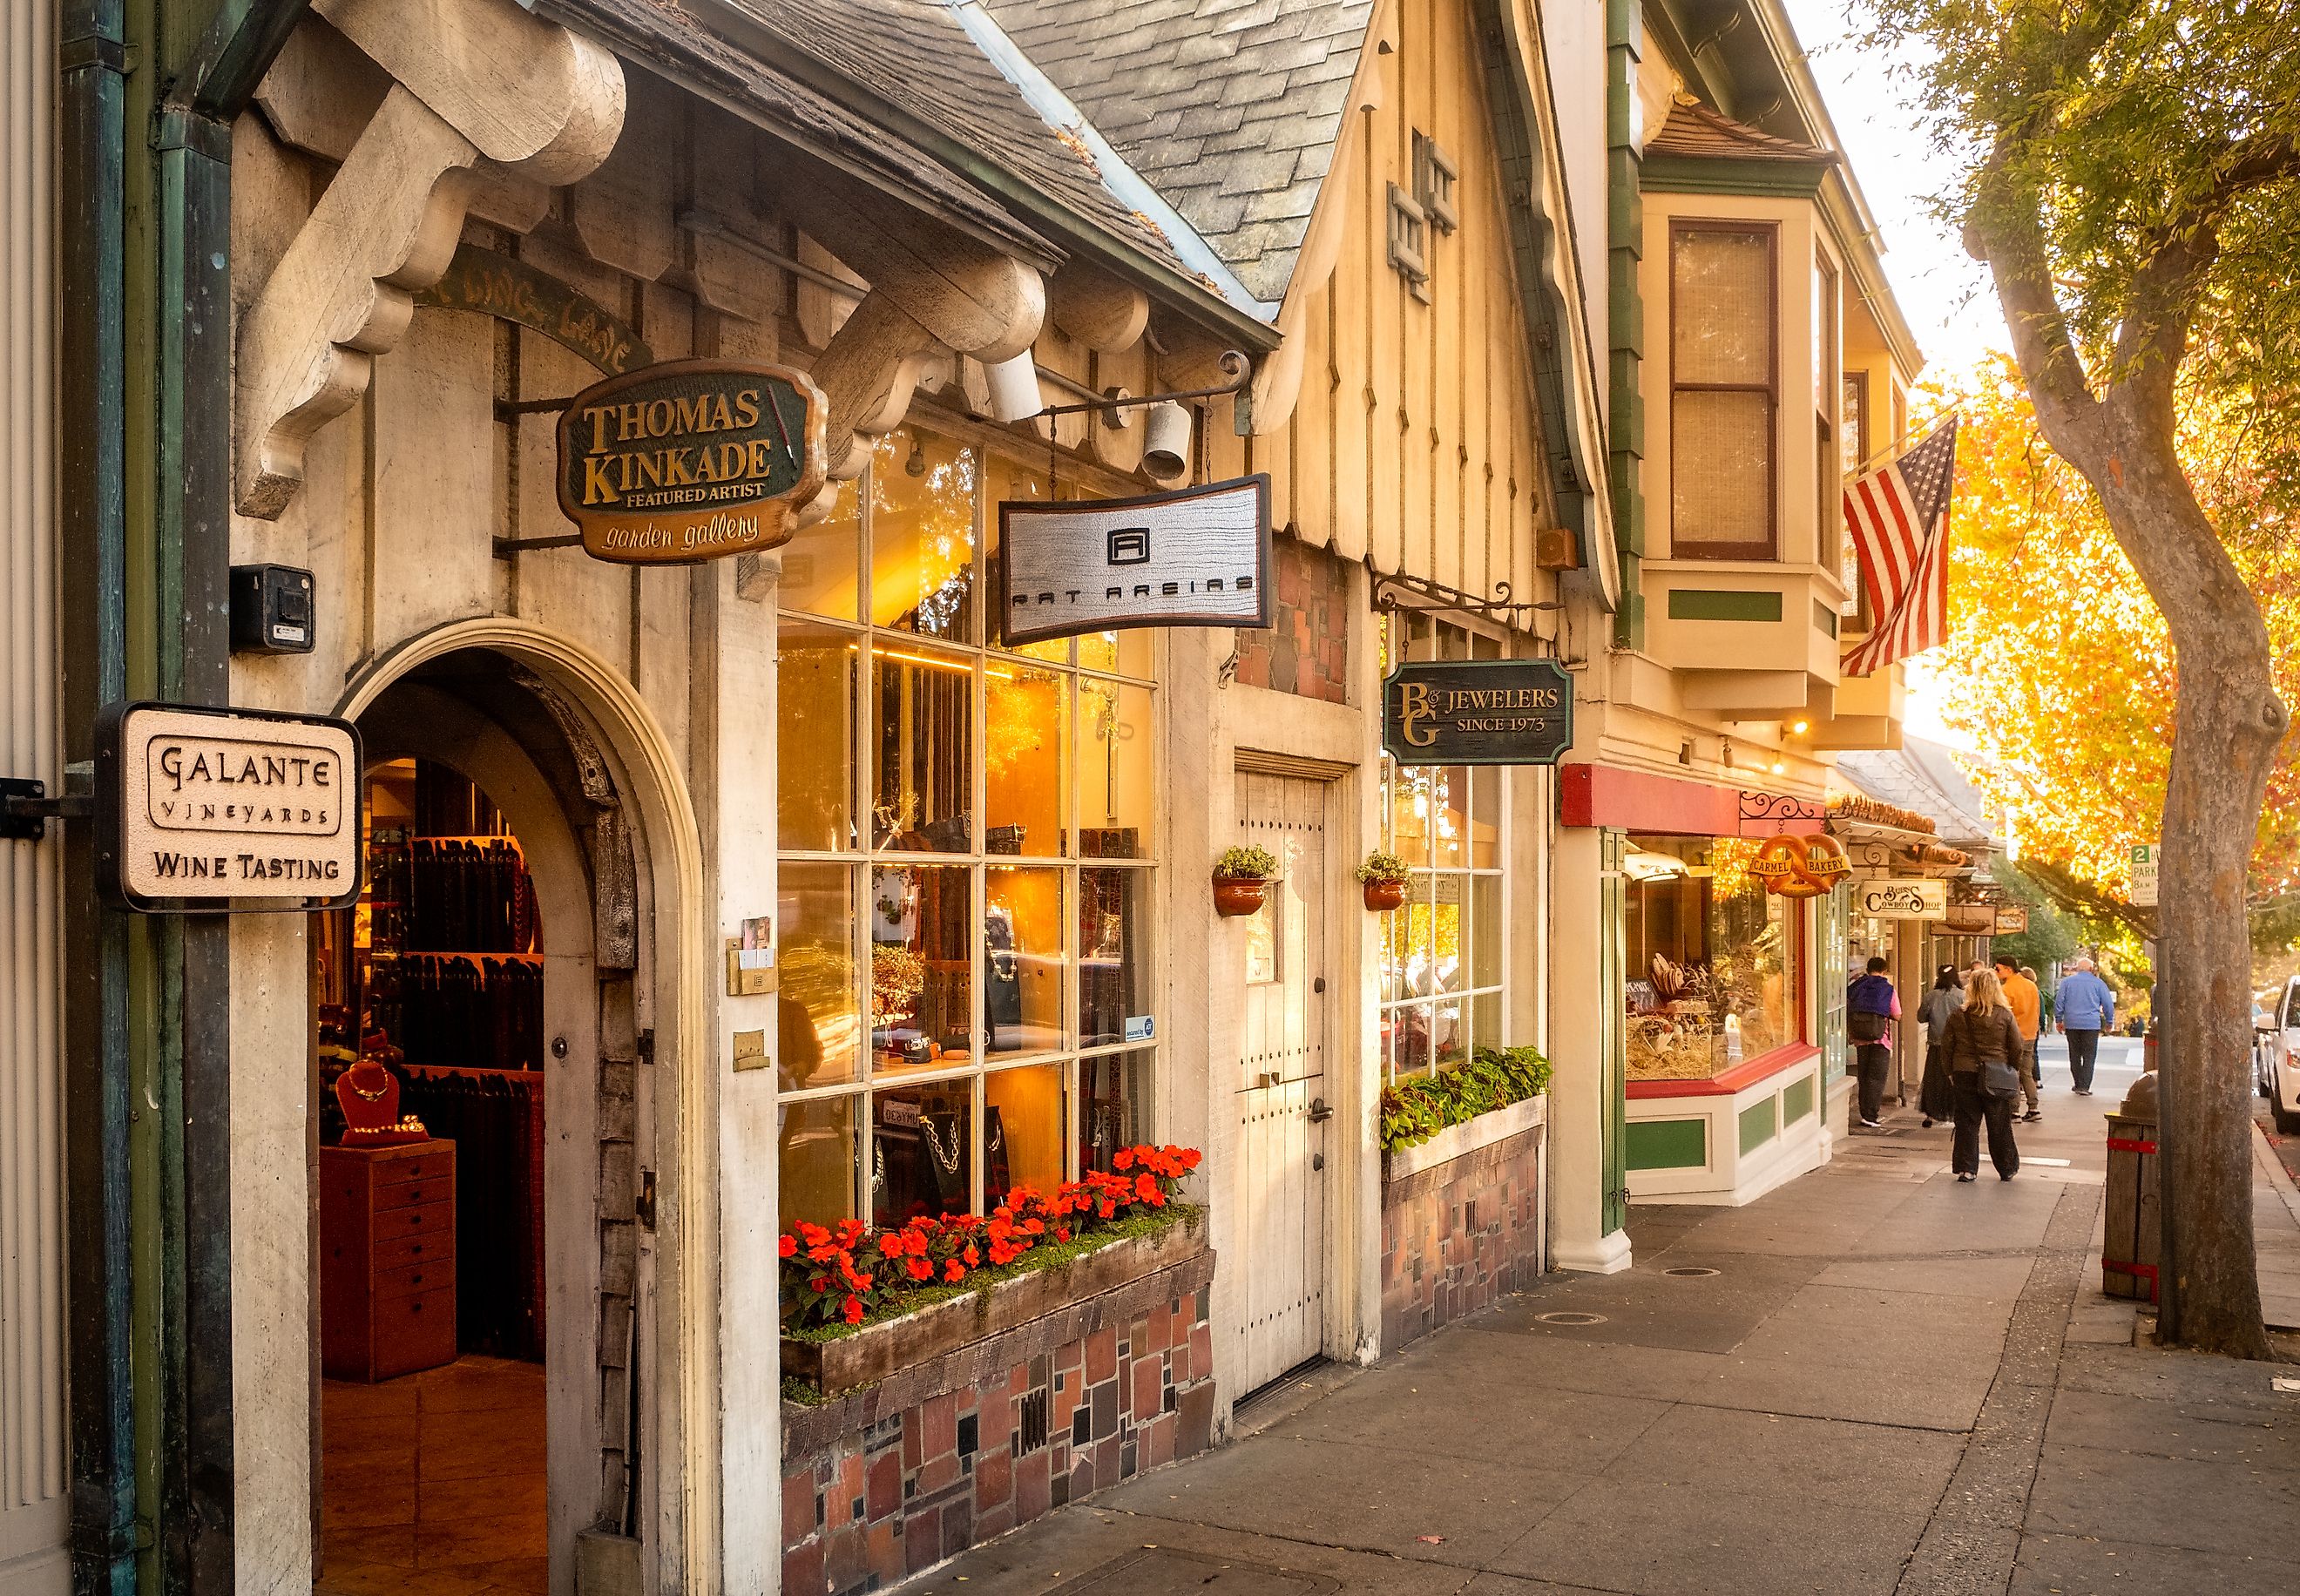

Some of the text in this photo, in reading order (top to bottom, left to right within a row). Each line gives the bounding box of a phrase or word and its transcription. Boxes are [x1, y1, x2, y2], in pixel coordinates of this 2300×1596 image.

[583, 389, 760, 455] THOMAS
[582, 439, 771, 505] KINKADE
[627, 483, 765, 508] FEATURED ARTIST
[602, 512, 759, 551] garden gallery
[1011, 575, 1253, 607] PAT AREIAS
[1444, 687, 1559, 714] JEWELERS
[1457, 717, 1545, 732] SINCE 1973
[160, 746, 330, 792] GALANTE
[161, 801, 328, 824] VINEYARDS
[153, 851, 339, 879] WINE TASTING
[1753, 858, 1843, 872] CARMEL BAKERY
[2135, 848, 2145, 862] 2
[1865, 892, 1910, 912] COWBOY
